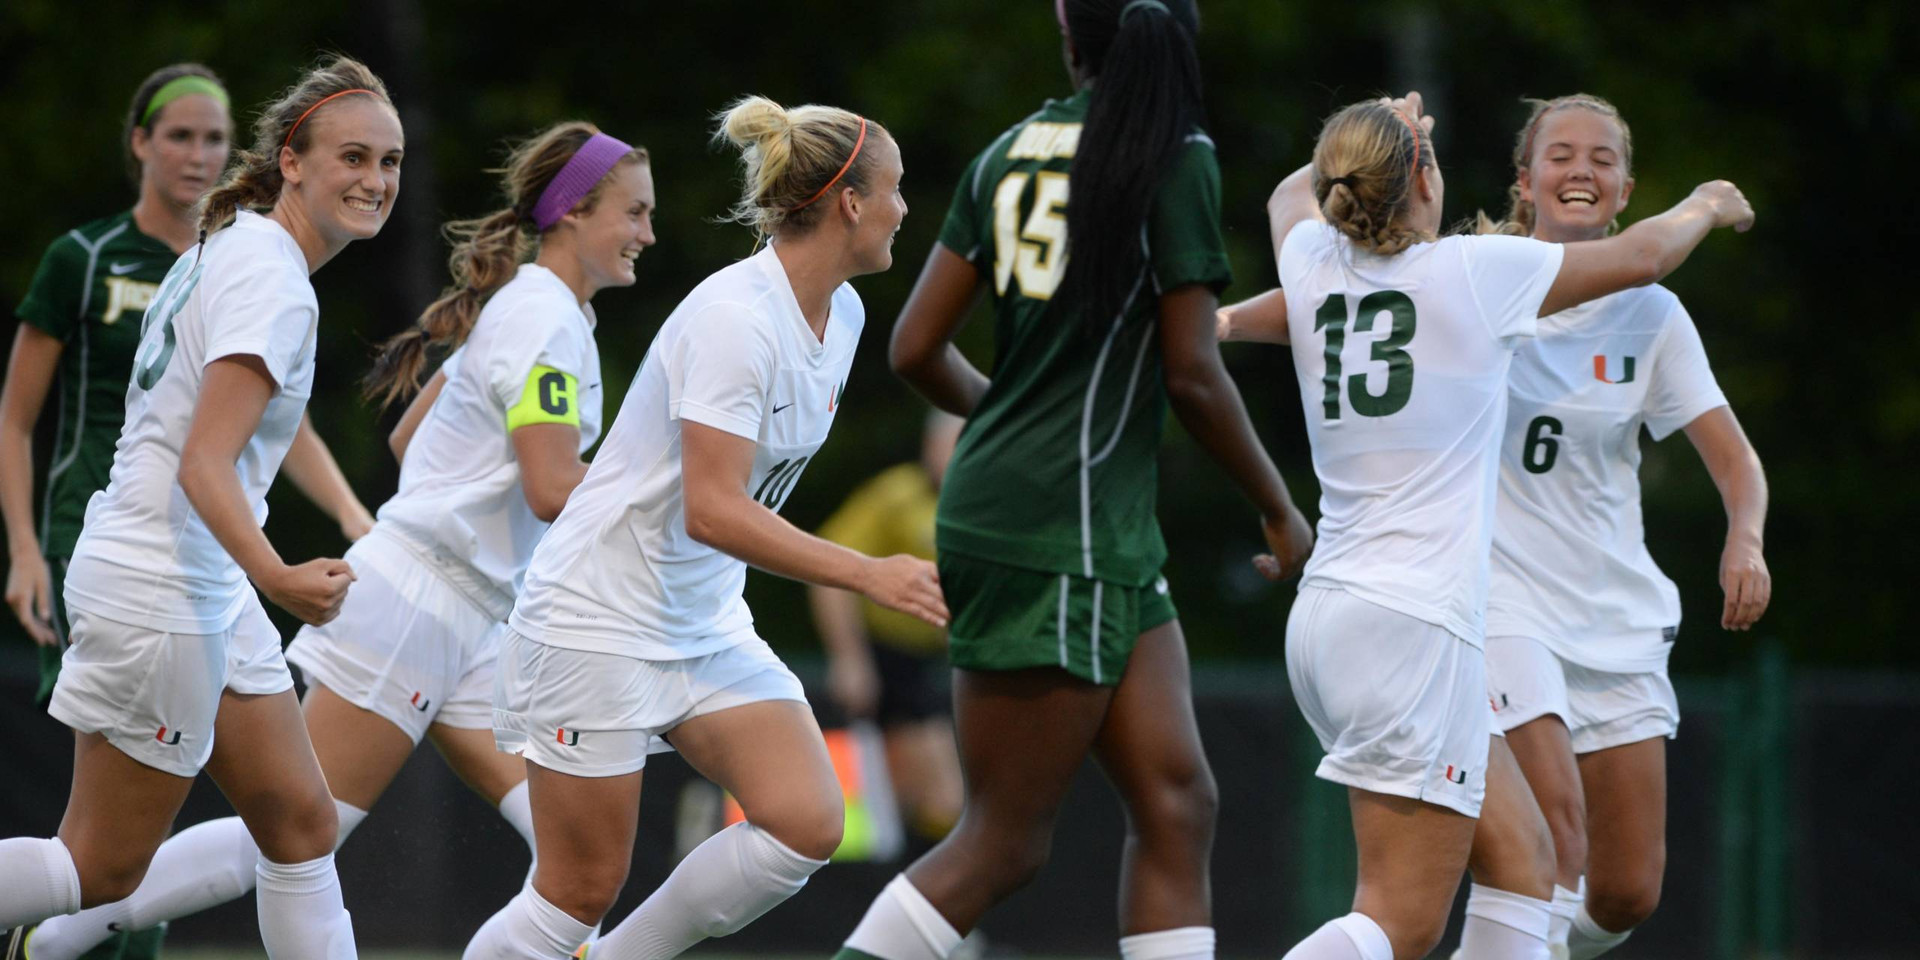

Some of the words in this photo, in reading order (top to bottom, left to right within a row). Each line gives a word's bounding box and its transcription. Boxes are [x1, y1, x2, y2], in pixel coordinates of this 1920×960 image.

[992, 170, 1070, 301] 15
[1313, 289, 1417, 421] 13
[1593, 354, 1636, 384] U
[538, 372, 568, 416] C
[1522, 415, 1563, 474] 6
[752, 456, 808, 510] 10
[410, 691, 430, 712] U
[155, 725, 181, 745] U
[556, 728, 579, 746] U
[1446, 764, 1467, 785] U
